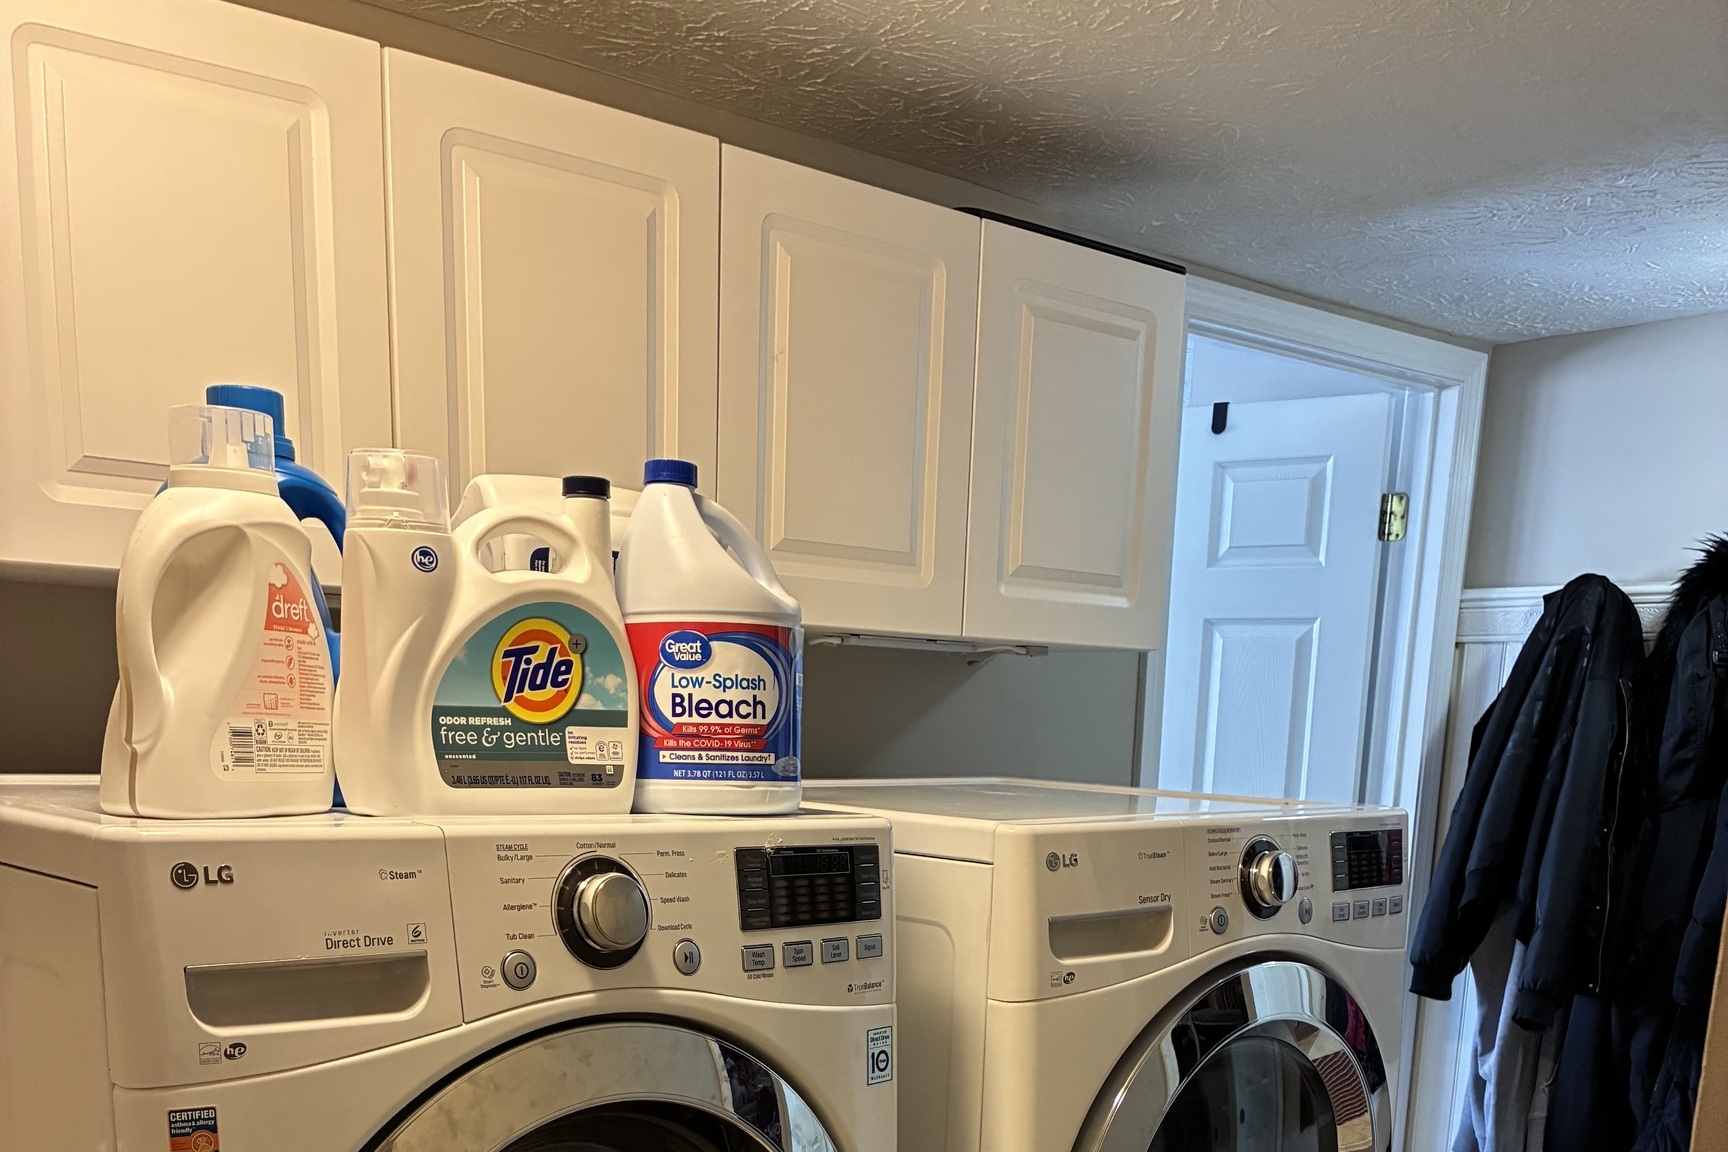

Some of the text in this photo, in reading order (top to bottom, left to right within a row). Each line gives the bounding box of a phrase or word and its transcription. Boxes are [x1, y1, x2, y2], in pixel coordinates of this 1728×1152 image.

[272, 594, 310, 621] dreft
[665, 640, 702, 653] Great
[674, 650, 702, 661] Value
[501, 644, 574, 705] Tide
[671, 673, 766, 692] Low-Splash
[671, 693, 766, 719] Bleach
[439, 716, 512, 726] ODOR REFRESH
[440, 727, 478, 745] free
[482, 727, 500, 747] &
[705, 753, 739, 761] Sanitizes
[591, 773, 603, 782] 83
[702, 770, 711, 778] QT
[712, 770, 726, 778] (121
[497, 853, 533, 862] Bulky/Large
[500, 877, 525, 885] Sanitary
[660, 896, 674, 904] Speed
[1139, 893, 1171, 904] Sensor Dry
[680, 923, 693, 931] Cycle
[505, 932, 535, 941] Tub Clean
[325, 935, 394, 950] Direct Drive
[871, 1049, 890, 1075] 10
[170, 1109, 215, 1121] CERTIFIED
